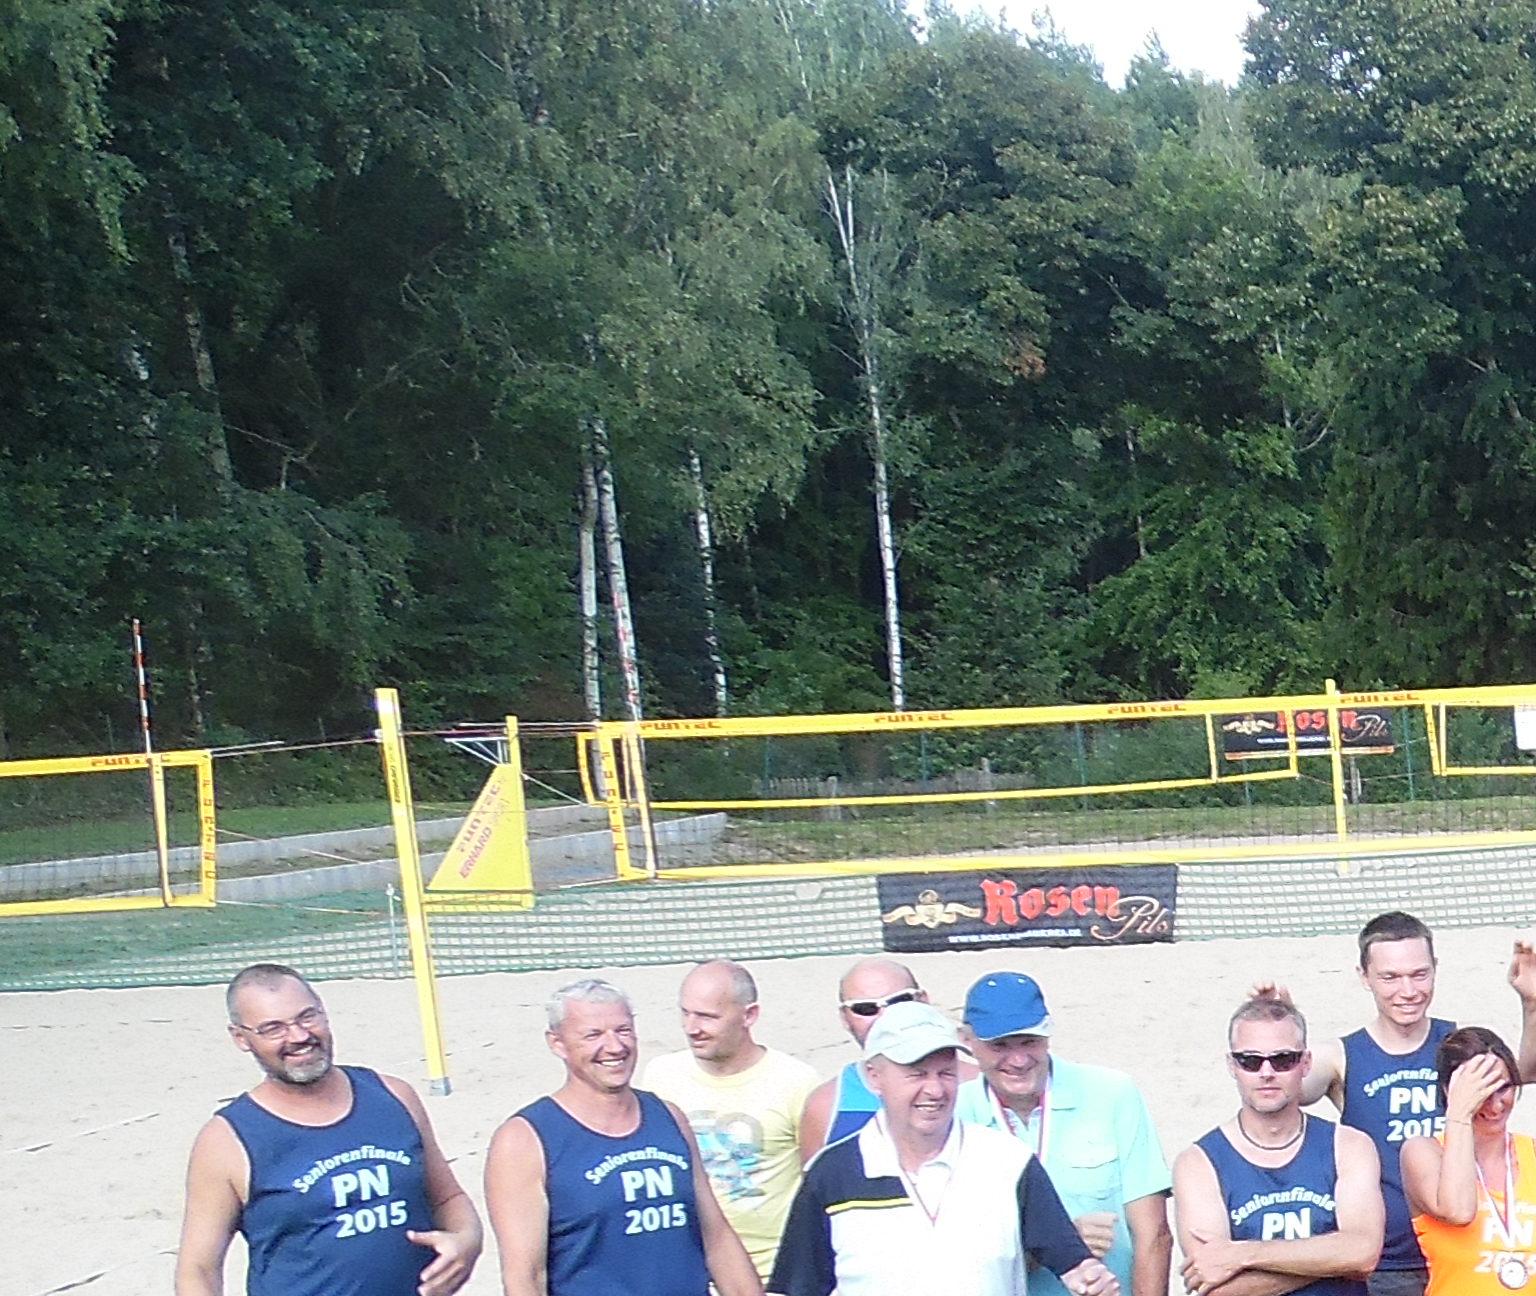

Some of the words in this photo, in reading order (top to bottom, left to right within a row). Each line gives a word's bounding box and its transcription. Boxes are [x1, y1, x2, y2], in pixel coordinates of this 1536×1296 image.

[979, 879, 1121, 927] Rosen
[1090, 895, 1169, 941] Pils
[1389, 1084, 1437, 1115] PN
[1386, 1116, 1447, 1142] 2015
[291, 1144, 411, 1194] Seniorenfinale
[584, 1146, 689, 1186] Seniorenfinale
[620, 1165, 674, 1203] PN
[331, 1164, 390, 1208] PN
[336, 1200, 408, 1239] 2015
[624, 1202, 688, 1235] 2015
[1261, 1207, 1312, 1241] PN
